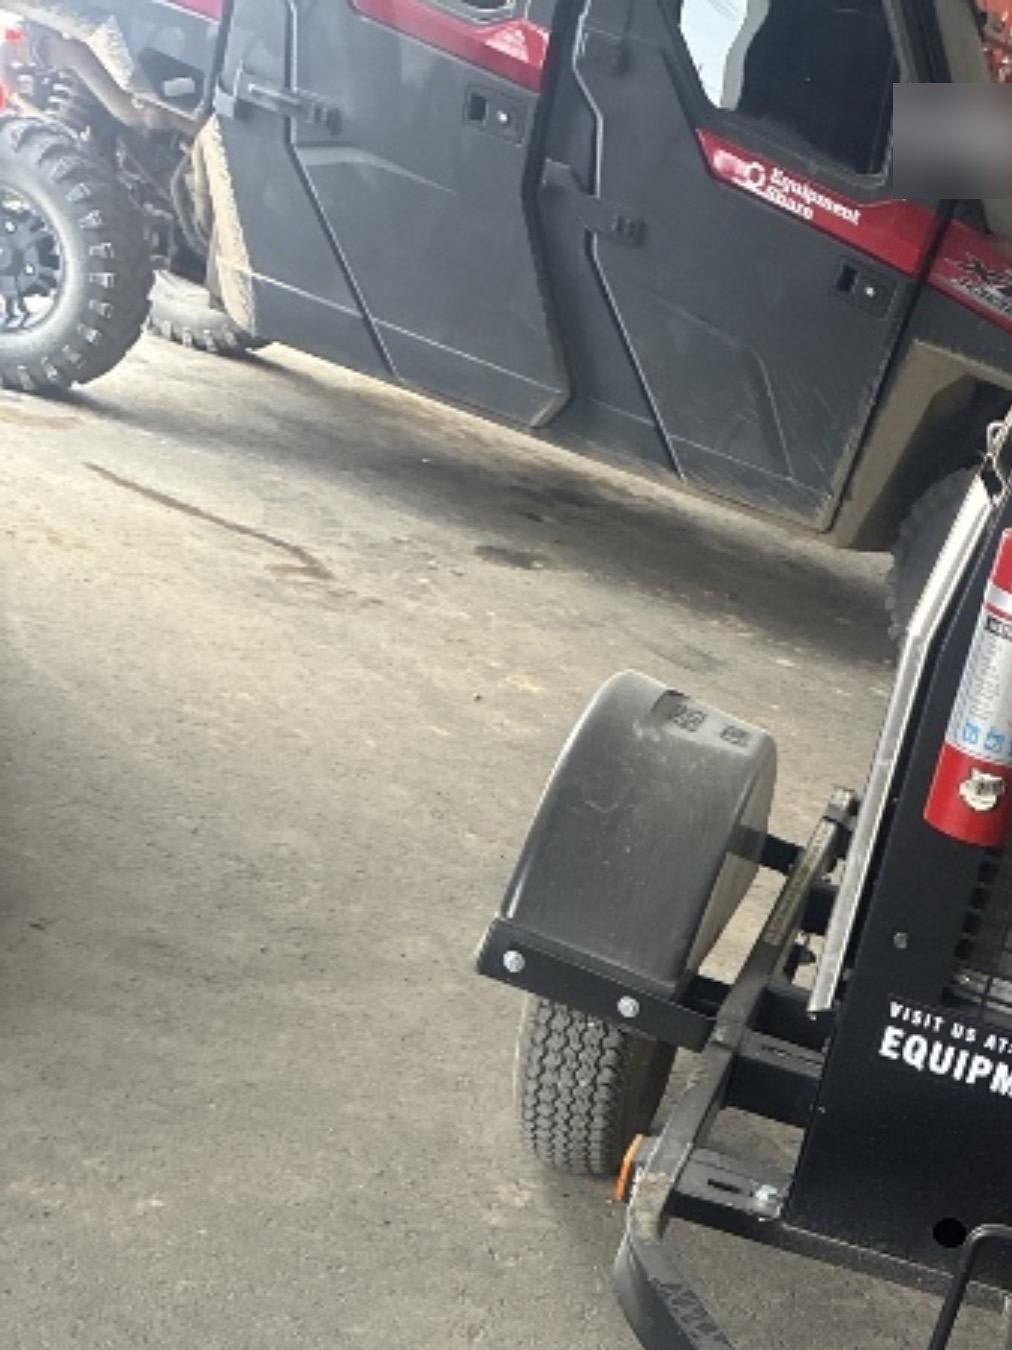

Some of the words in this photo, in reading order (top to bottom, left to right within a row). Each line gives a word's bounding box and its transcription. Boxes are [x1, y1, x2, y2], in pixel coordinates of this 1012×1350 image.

[765, 185, 814, 220] Share
[769, 167, 862, 227] Equipment
[889, 1001, 945, 1033] VISIT
[950, 1021, 978, 1043] US
